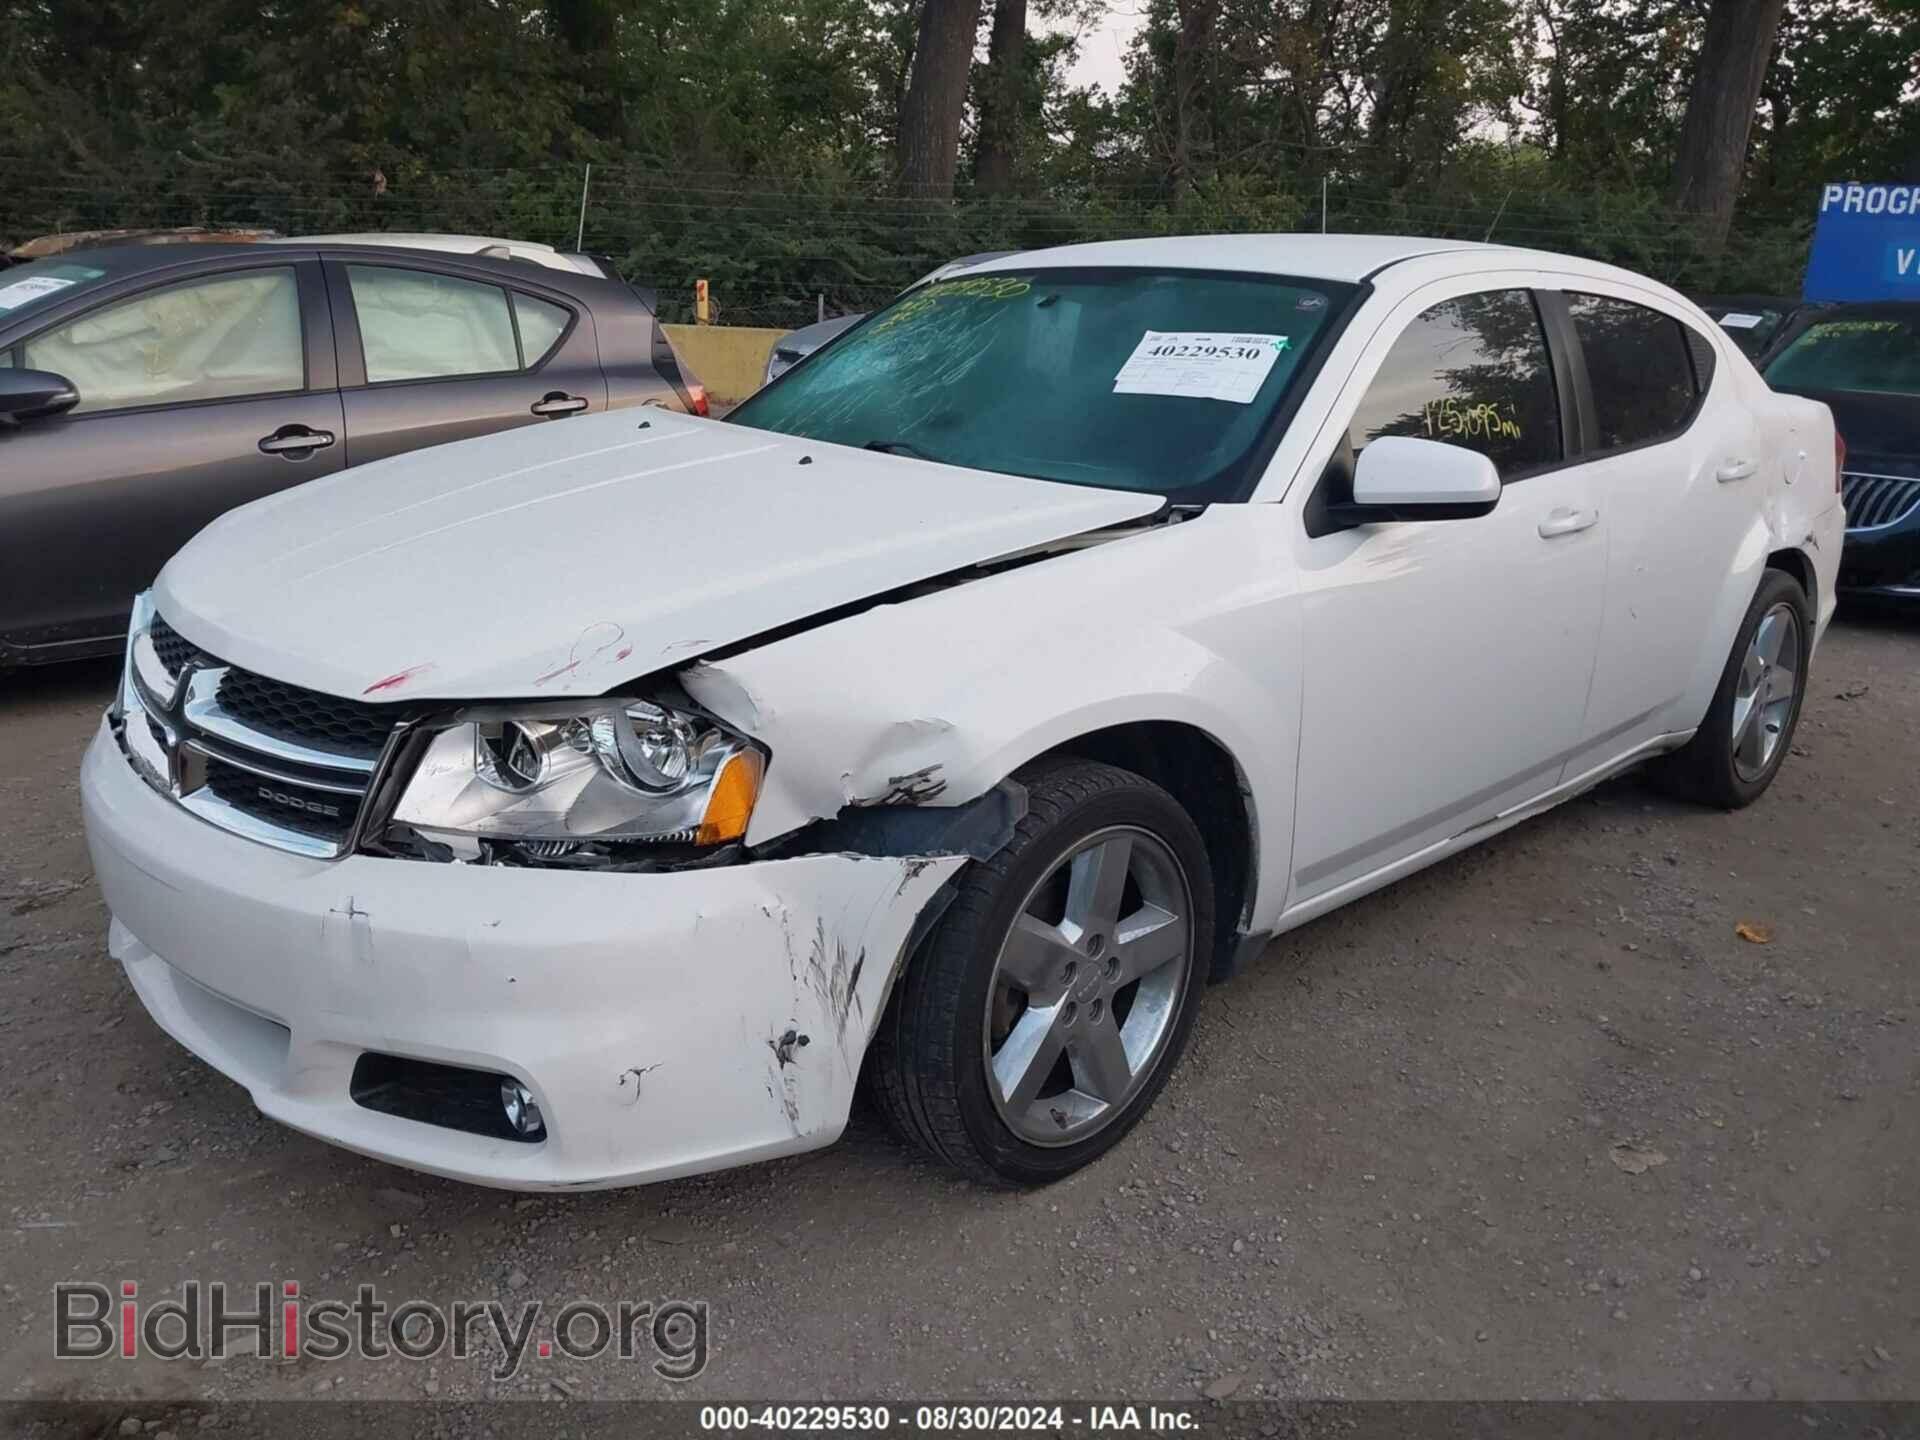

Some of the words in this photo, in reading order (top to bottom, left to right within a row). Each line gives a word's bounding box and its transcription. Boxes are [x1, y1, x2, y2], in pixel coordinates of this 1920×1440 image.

[1896, 248, 1920, 276] V
[1148, 345, 1261, 360] 40229530
[257, 787, 340, 817] DODGE
